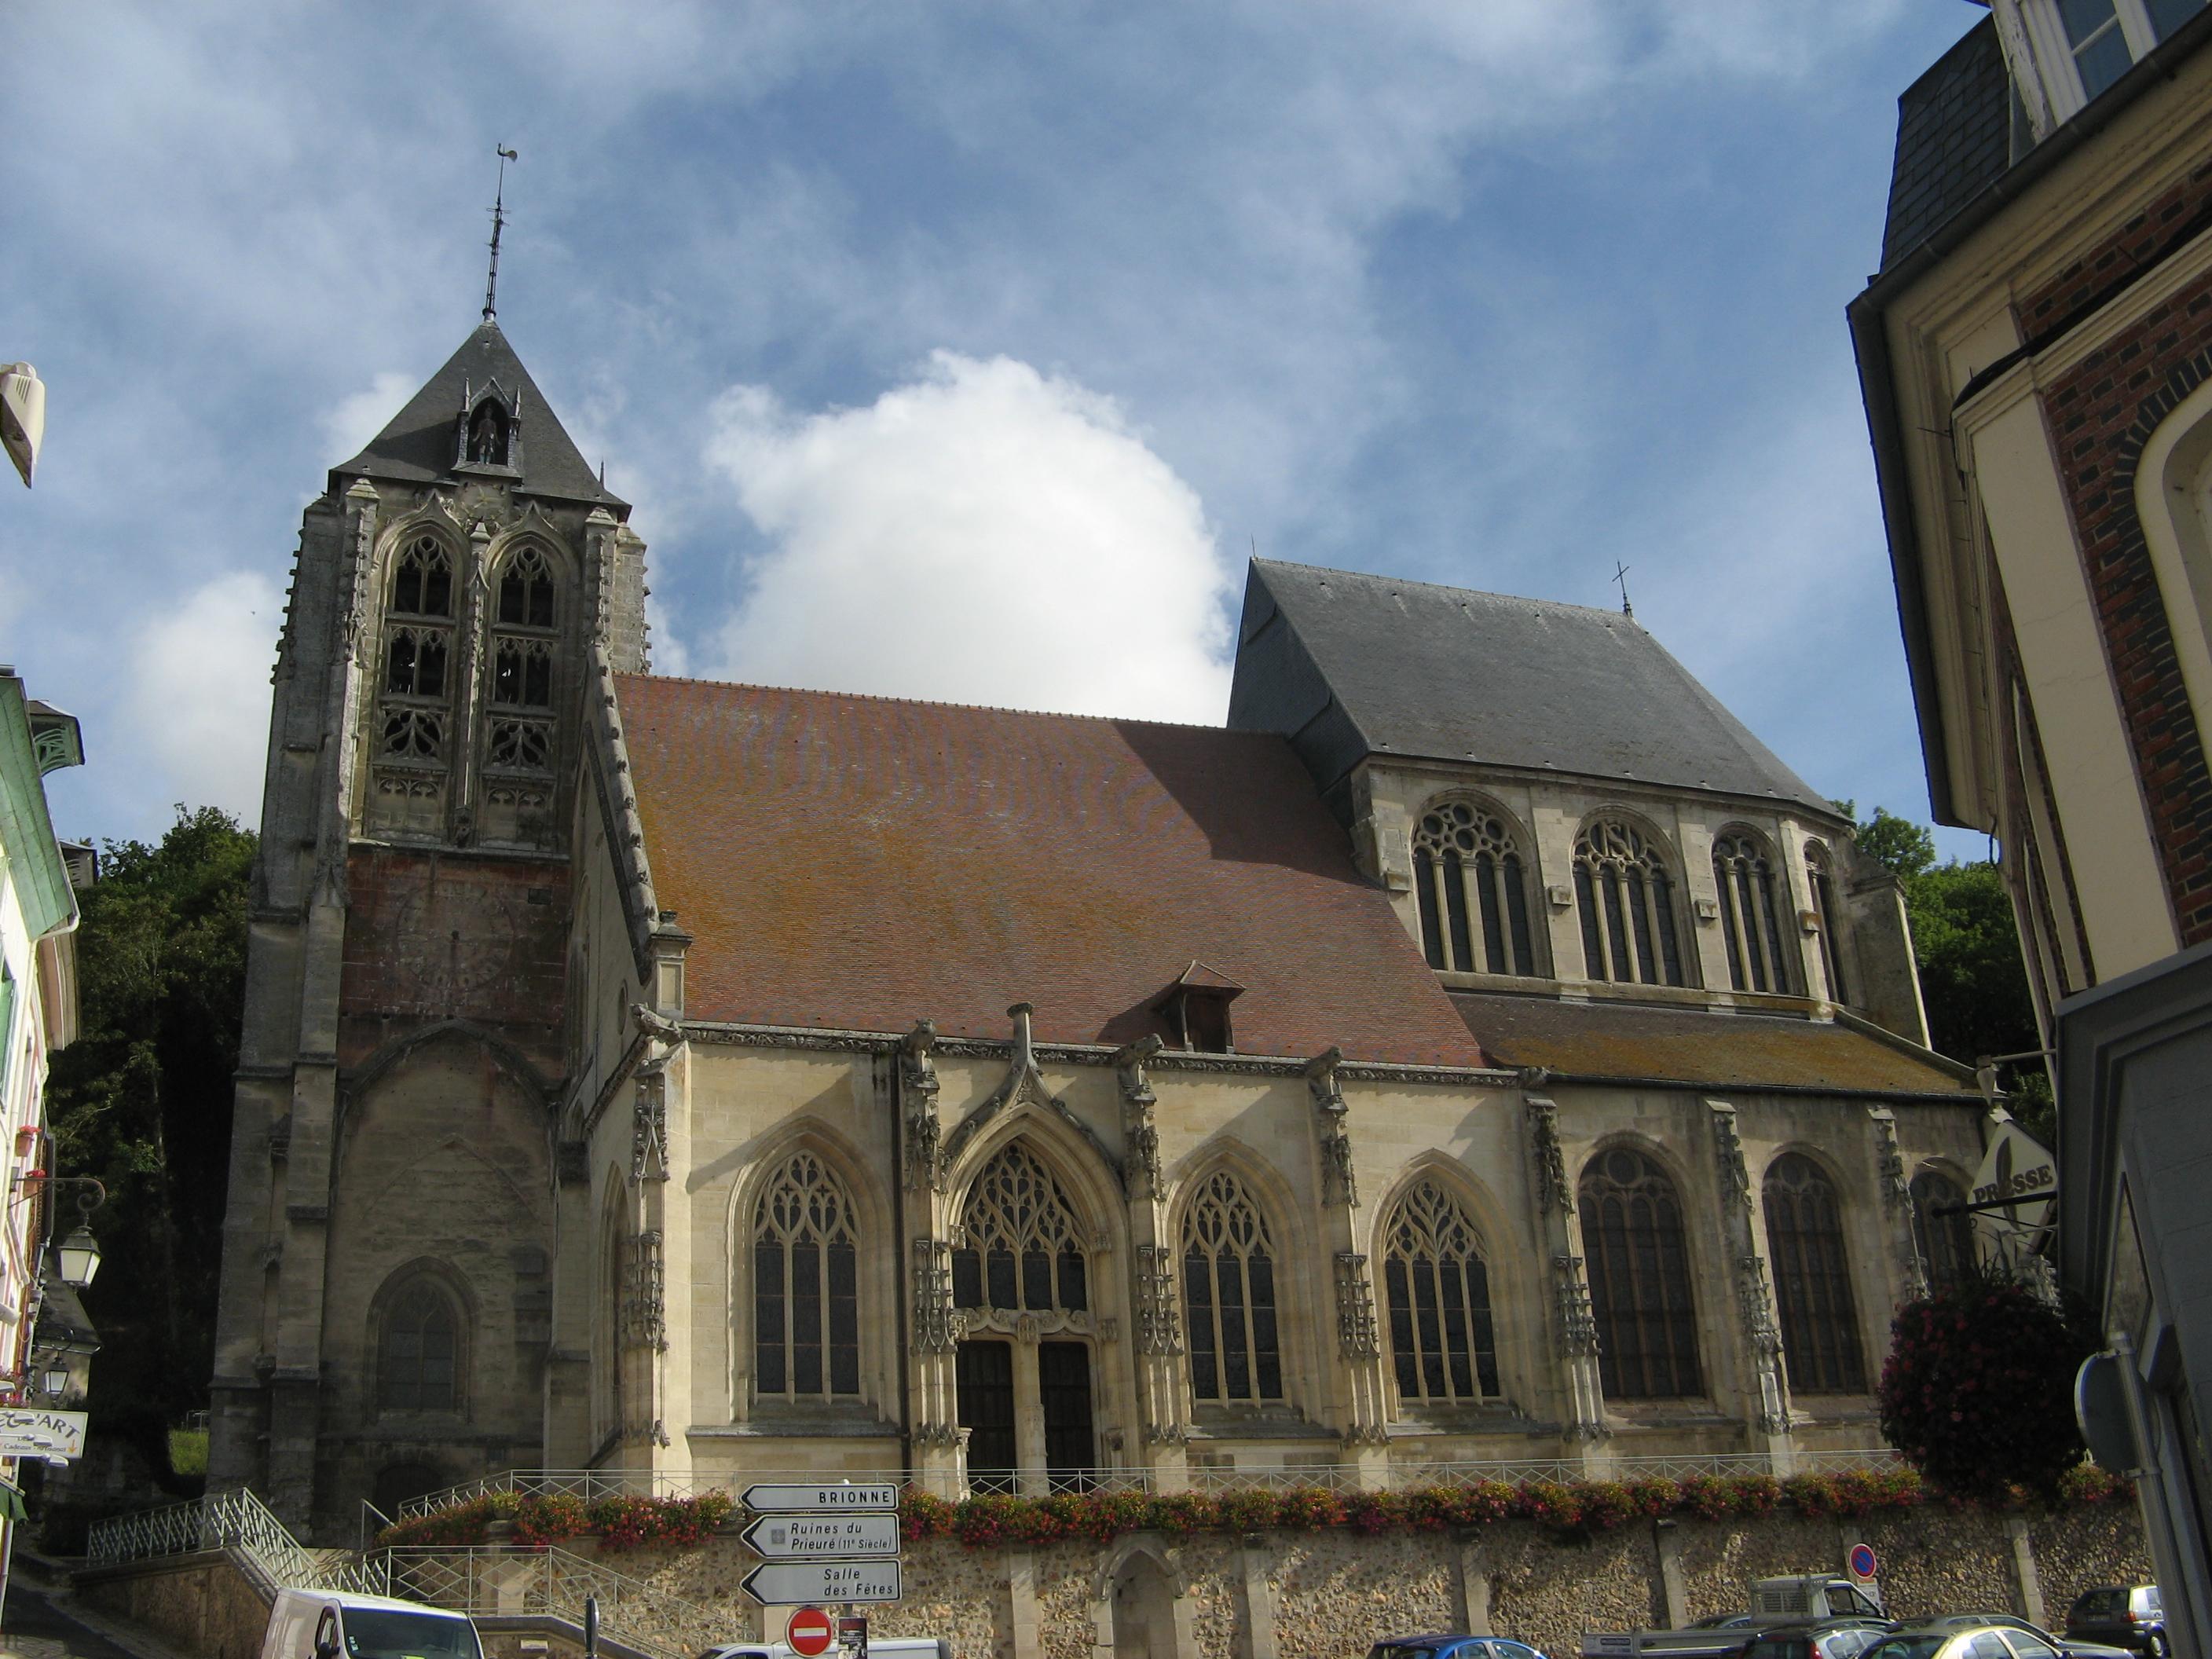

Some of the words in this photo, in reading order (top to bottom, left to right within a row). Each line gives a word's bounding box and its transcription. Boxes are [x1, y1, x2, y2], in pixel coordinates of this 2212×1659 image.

[819, 1491, 890, 1503] BRIONNE
[791, 1522, 838, 1534] Ruines
[847, 1522, 862, 1533] du
[791, 1538, 835, 1550] Prieuré
[858, 1536, 892, 1549] Siècle)
[824, 1569, 860, 1580] Salle
[824, 1584, 847, 1596] des
[855, 1583, 892, 1595] Fêtes
